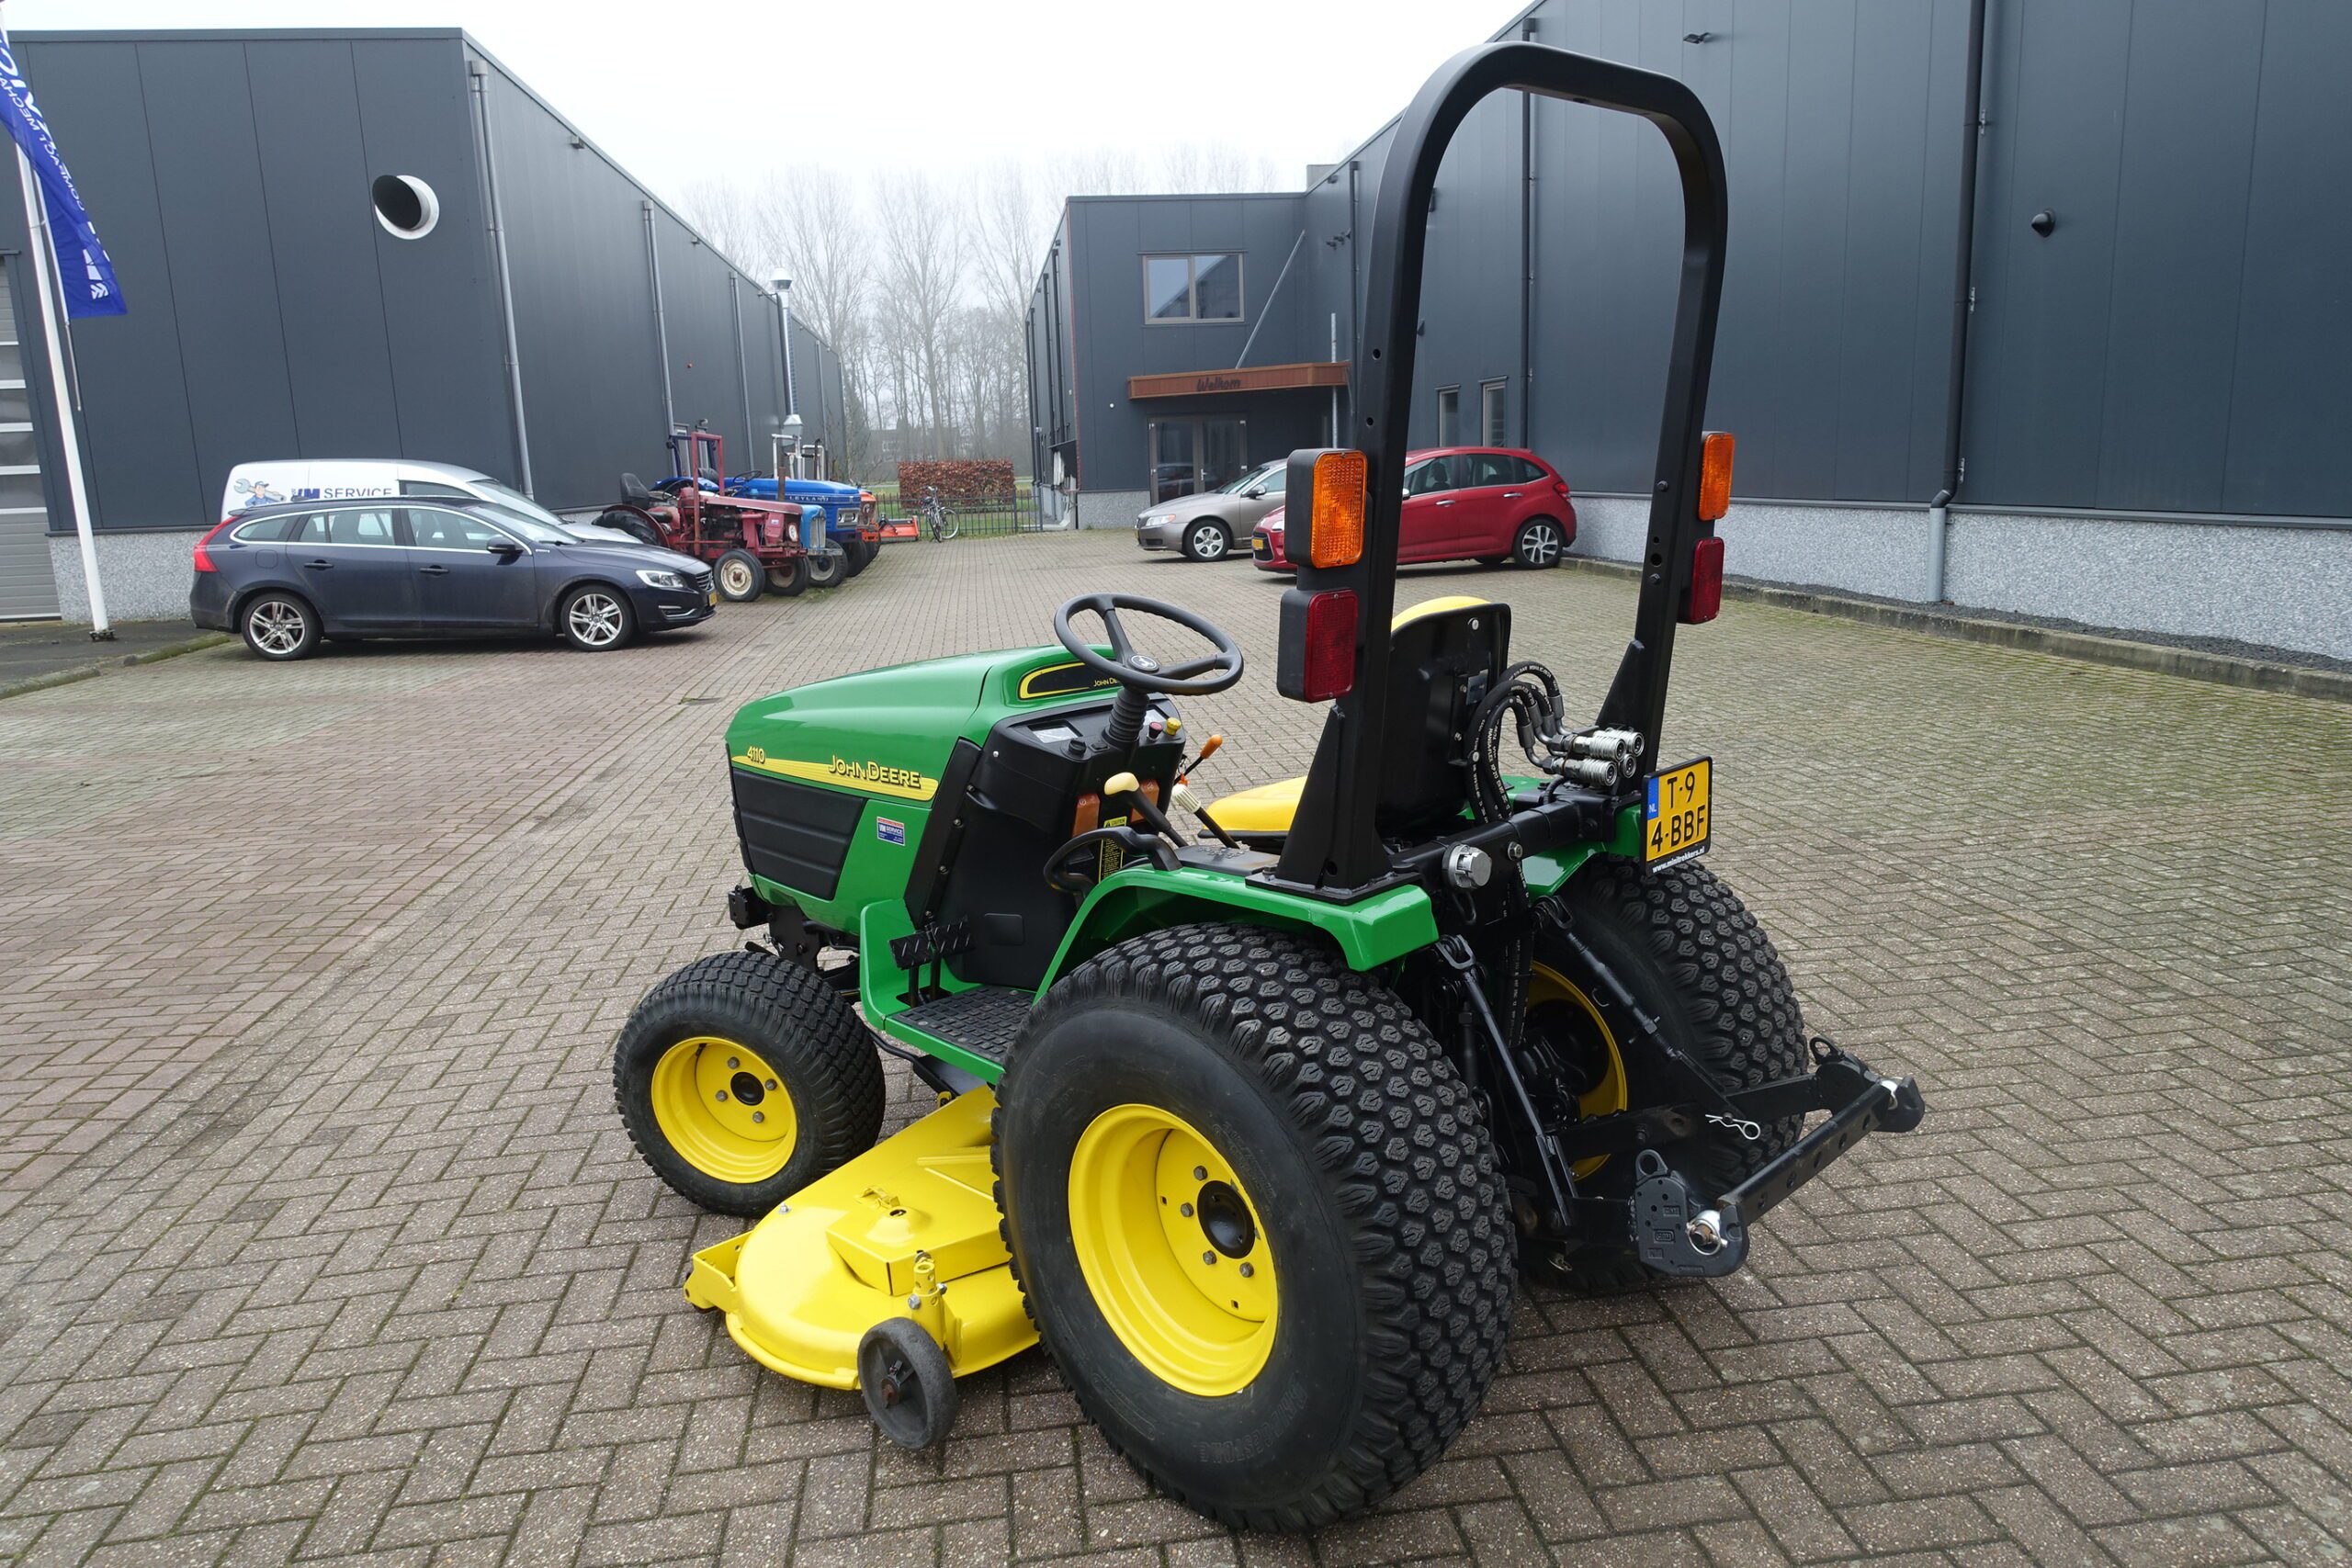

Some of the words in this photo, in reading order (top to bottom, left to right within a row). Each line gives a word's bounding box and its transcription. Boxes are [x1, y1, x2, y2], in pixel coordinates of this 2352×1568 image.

[747, 745, 765, 763] 4110
[829, 755, 867, 780] JOHN
[867, 761, 922, 789] DEERE
[1648, 803, 1657, 813] NL
[1653, 846, 1704, 873] www.minitrekkers.nl
